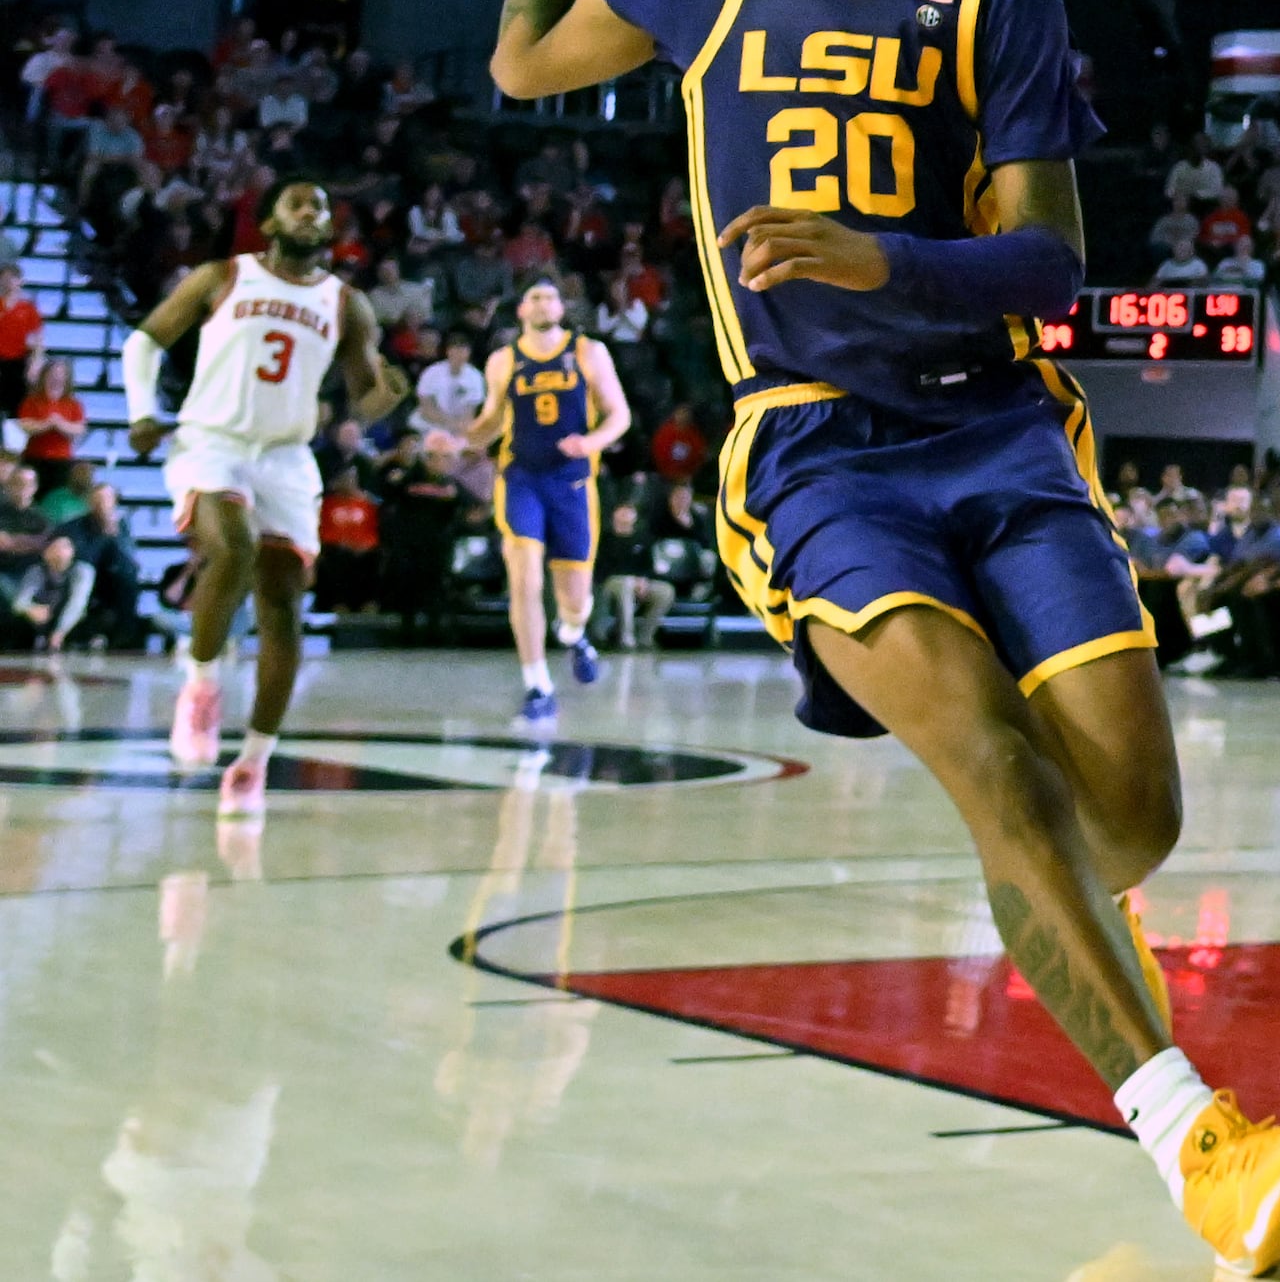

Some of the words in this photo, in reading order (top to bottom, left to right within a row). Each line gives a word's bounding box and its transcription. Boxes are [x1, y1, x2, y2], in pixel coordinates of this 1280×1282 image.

[739, 30, 942, 107] LSU
[766, 107, 915, 217] 20
[1110, 293, 1188, 327] 16:06
[256, 330, 295, 385] 3
